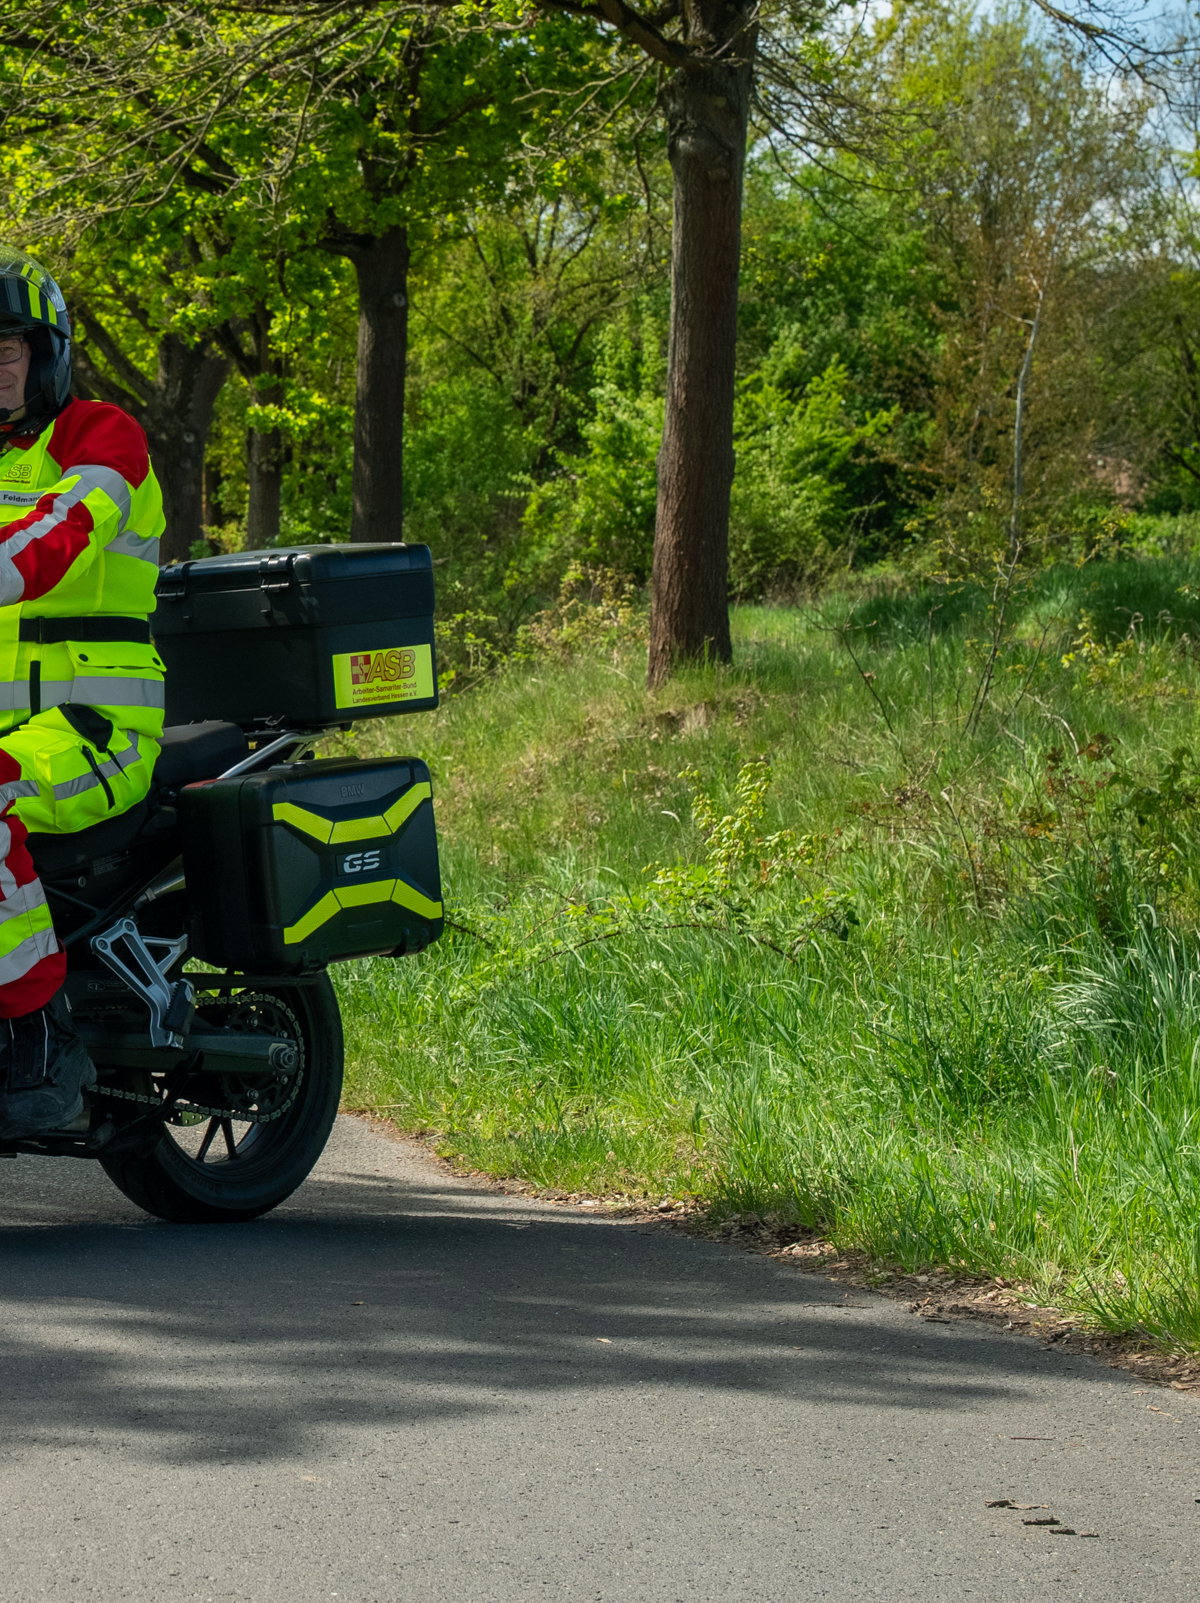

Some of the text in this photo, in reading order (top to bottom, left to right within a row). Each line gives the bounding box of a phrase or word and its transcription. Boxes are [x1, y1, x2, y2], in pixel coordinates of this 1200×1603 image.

[3, 494, 40, 503] Feldman
[367, 650, 415, 683] ASB
[352, 682, 417, 695] Arbeiter-Samariter-Bund
[352, 694, 391, 704] Landesverband
[391, 691, 409, 700] Hessen
[341, 784, 365, 797] BMW
[343, 850, 380, 873] GS
